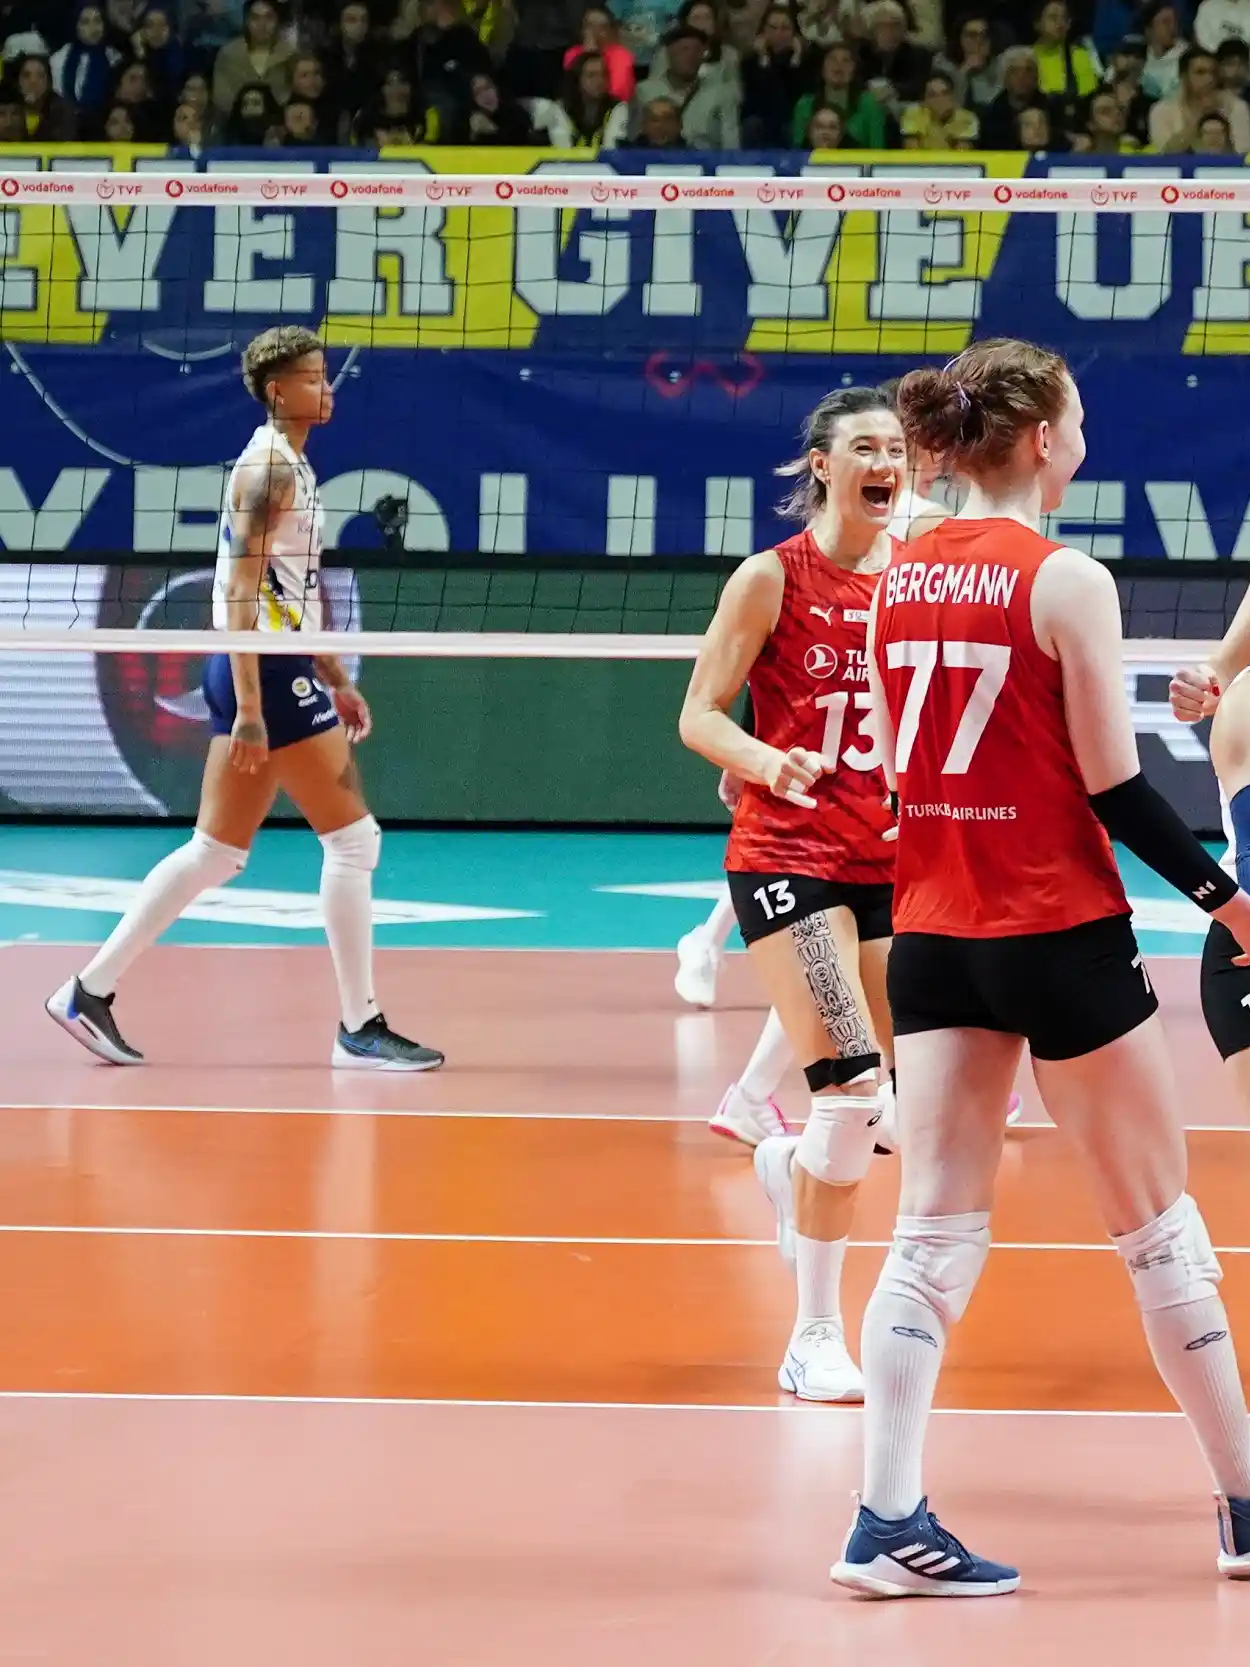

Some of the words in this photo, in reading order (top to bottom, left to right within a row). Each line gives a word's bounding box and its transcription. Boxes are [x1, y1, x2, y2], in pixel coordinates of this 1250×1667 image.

[22, 181, 75, 193] vodafone
[117, 184, 143, 196] TVF
[186, 183, 239, 194] vodafone
[281, 184, 308, 197] TVF
[351, 183, 404, 195] vodafone
[446, 185, 473, 198] TVF
[516, 184, 569, 197] vodafone
[611, 187, 639, 200] TVF
[681, 186, 735, 198] vodafone
[778, 188, 804, 200] TVF
[848, 187, 902, 199] vodafone
[944, 189, 972, 202] TVF
[1015, 187, 1069, 200] vodafone
[1111, 191, 1138, 203] TVF
[1182, 188, 1236, 201] vodafone
[514, 161, 985, 320] GIVE
[885, 562, 1020, 608] BERGMANN
[886, 640, 1012, 774] 77
[815, 691, 883, 771] 13
[952, 806, 1017, 820] AIRLINES
[753, 880, 796, 920] 13
